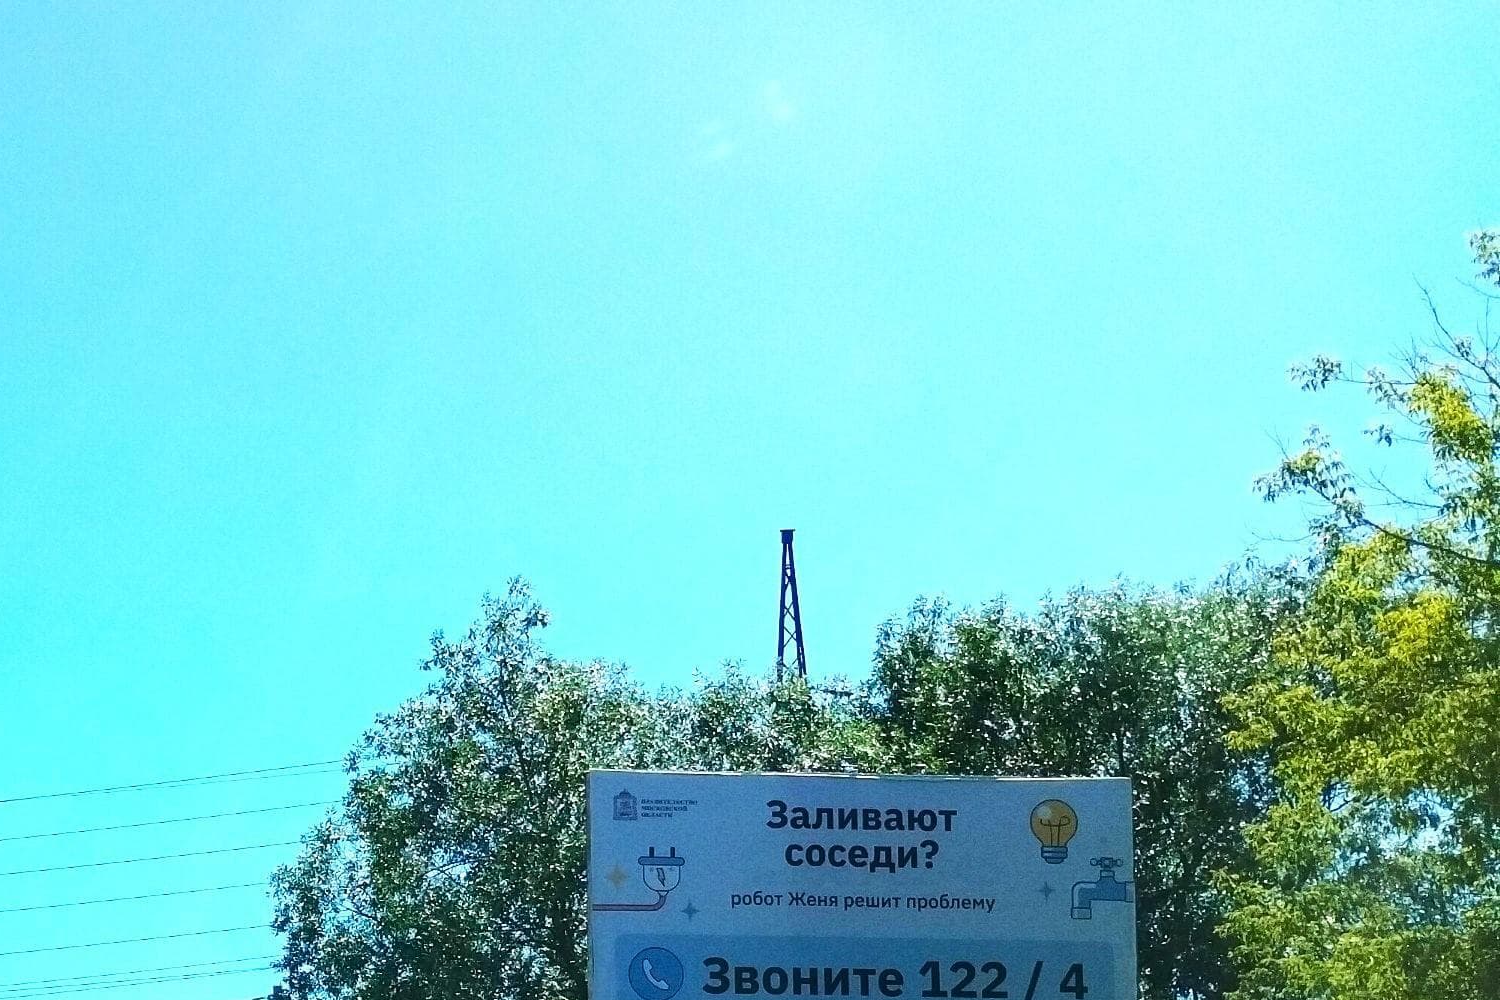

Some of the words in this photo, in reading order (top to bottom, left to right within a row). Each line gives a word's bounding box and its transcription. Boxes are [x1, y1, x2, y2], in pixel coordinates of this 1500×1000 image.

[766, 800, 957, 832] Заливают
[785, 840, 939, 873] соседи?
[731, 890, 783, 908] робот
[788, 892, 838, 907] Женя
[844, 895, 899, 911] решит
[907, 894, 996, 913] проблему
[702, 957, 904, 997] Звоните
[919, 961, 1008, 998] 122
